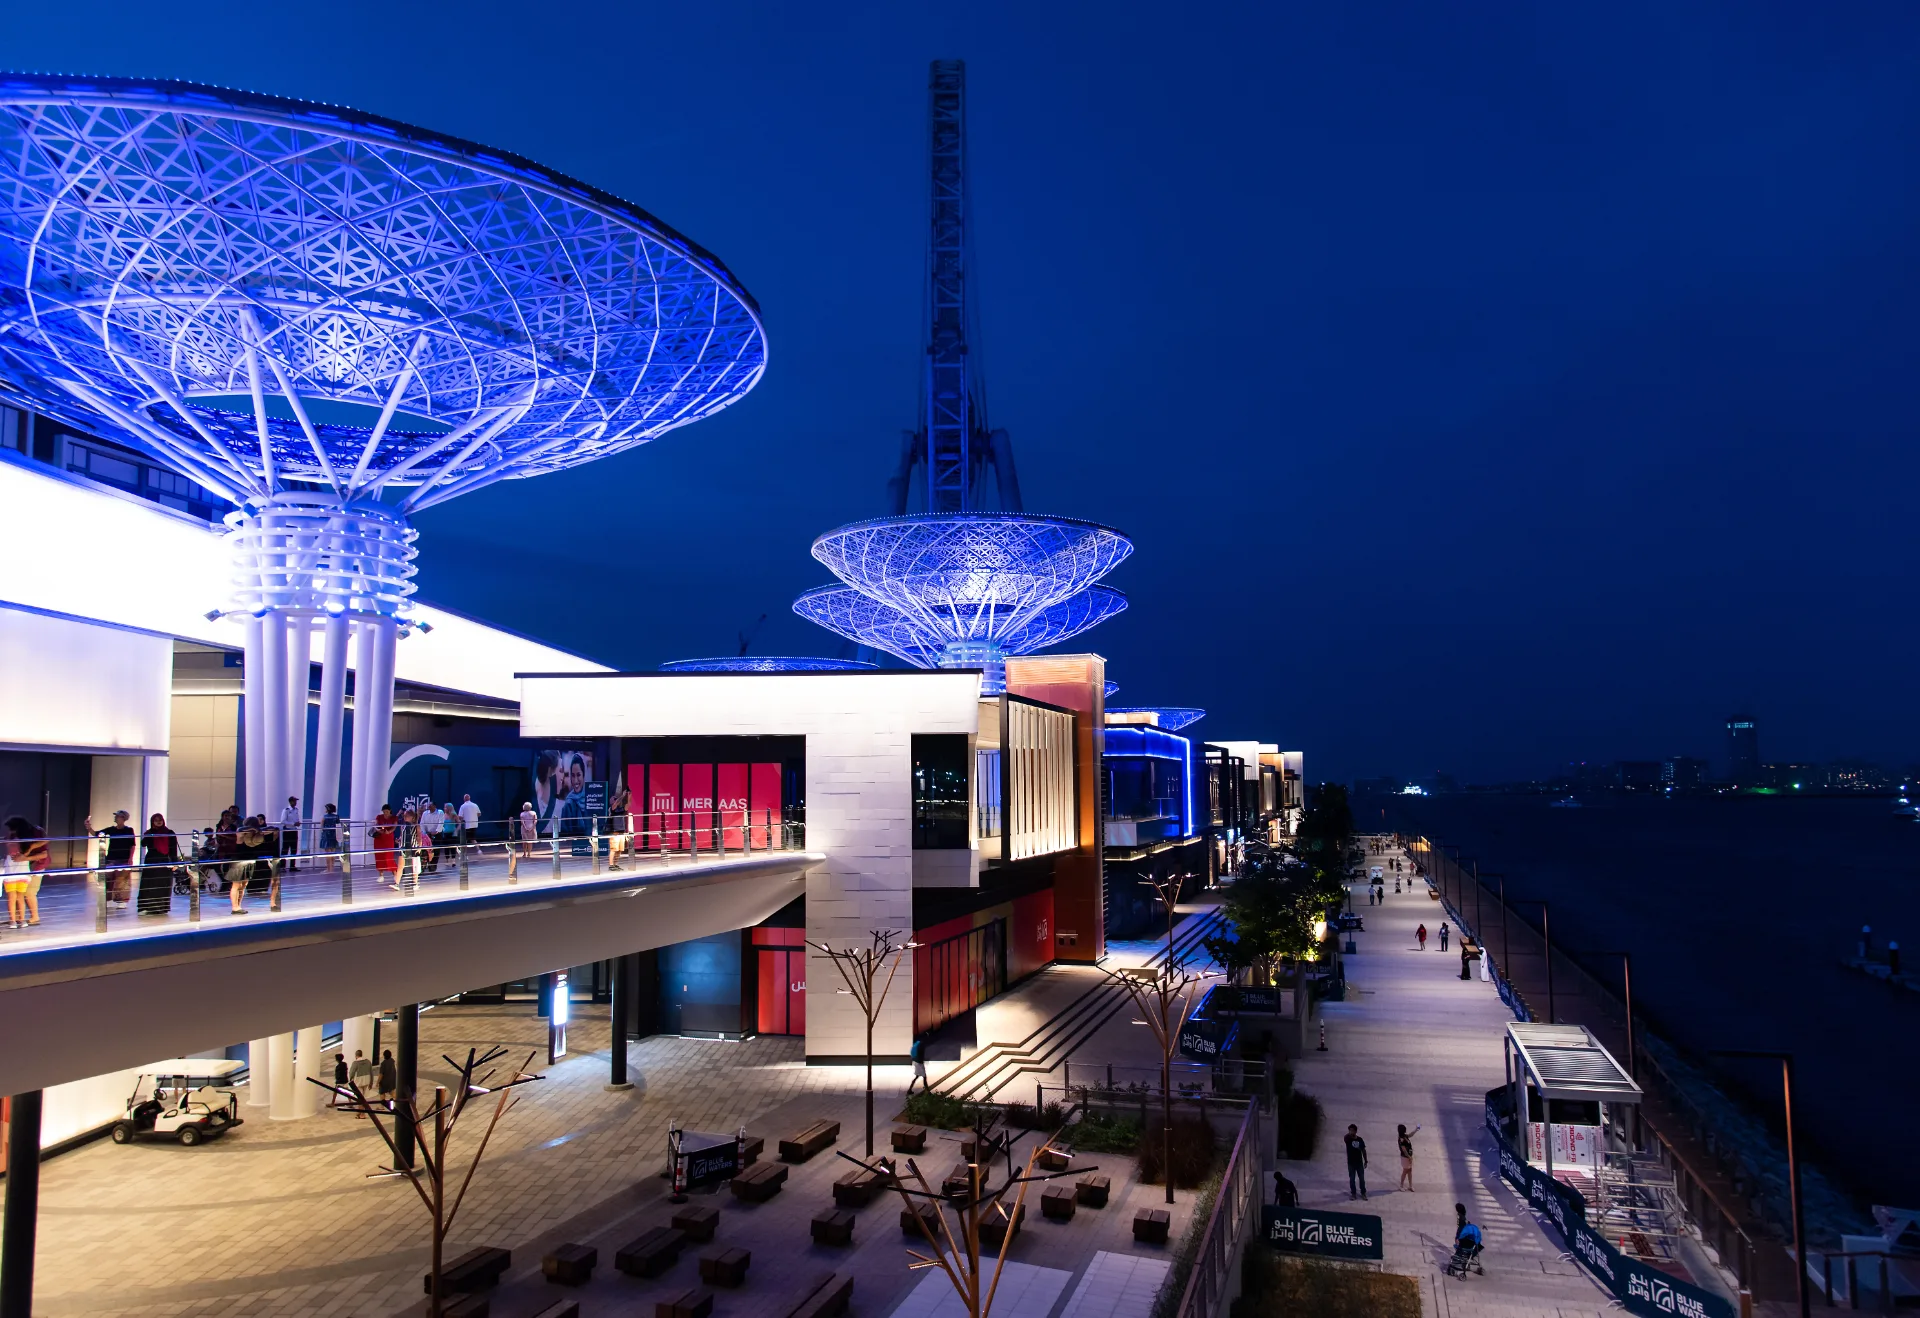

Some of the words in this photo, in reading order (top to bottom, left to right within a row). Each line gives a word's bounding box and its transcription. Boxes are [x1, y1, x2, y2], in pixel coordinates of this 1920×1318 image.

[683, 797, 748, 811] MERAAS
[708, 1157, 724, 1166] BLUE
[708, 1160, 733, 1172] WATERS
[1274, 1218, 1294, 1230] بلو
[1326, 1225, 1354, 1236] BLUE
[1326, 1234, 1372, 1247] WATERS
[1676, 1292, 1704, 1314] BLUE
